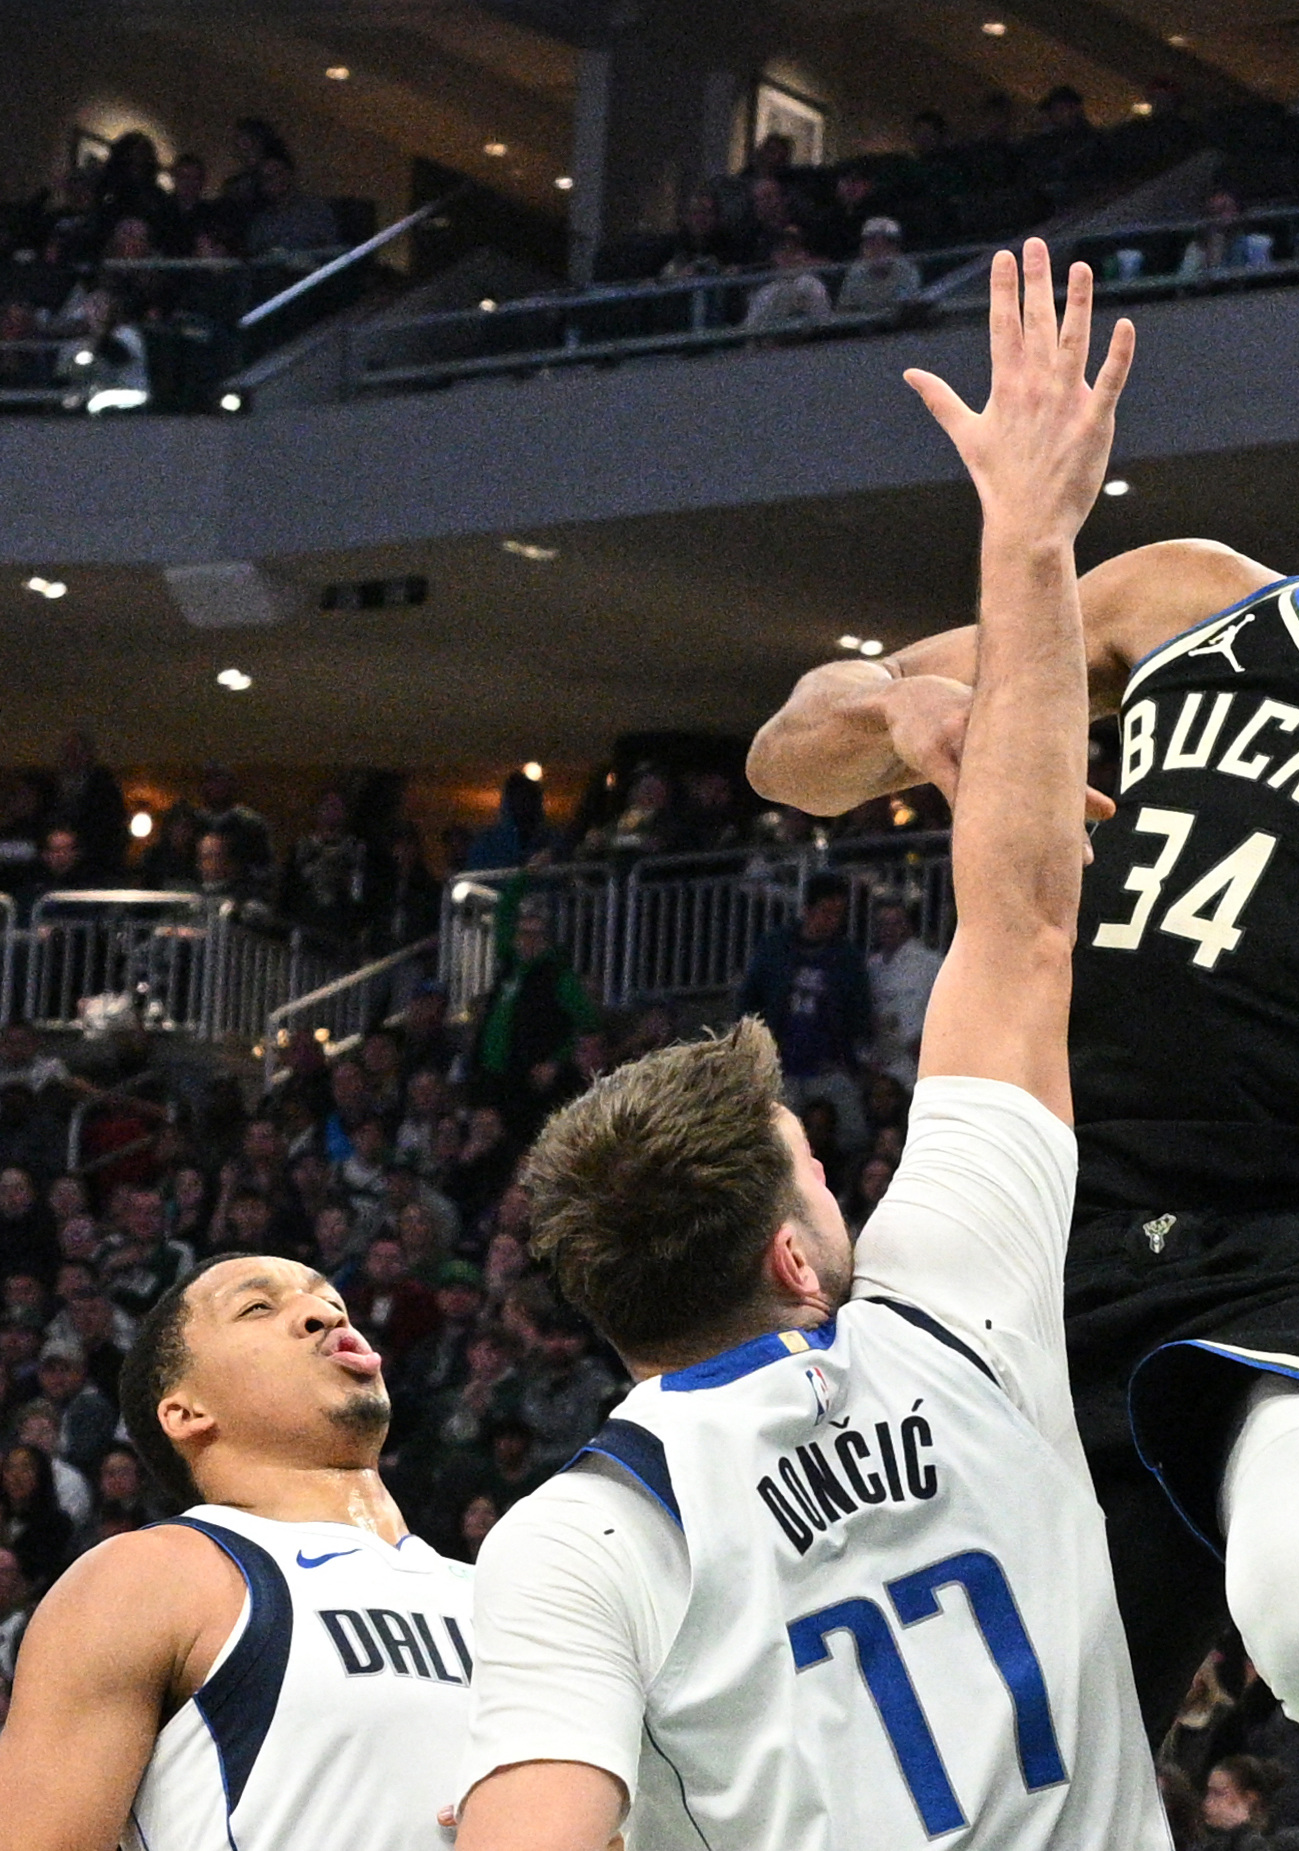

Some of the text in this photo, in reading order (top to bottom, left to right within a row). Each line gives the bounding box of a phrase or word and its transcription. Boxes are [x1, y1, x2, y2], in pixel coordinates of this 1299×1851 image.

[1092, 807, 1278, 969] 34
[756, 1398, 939, 1556] DONČIĆ
[786, 1548, 1070, 1841] 77
